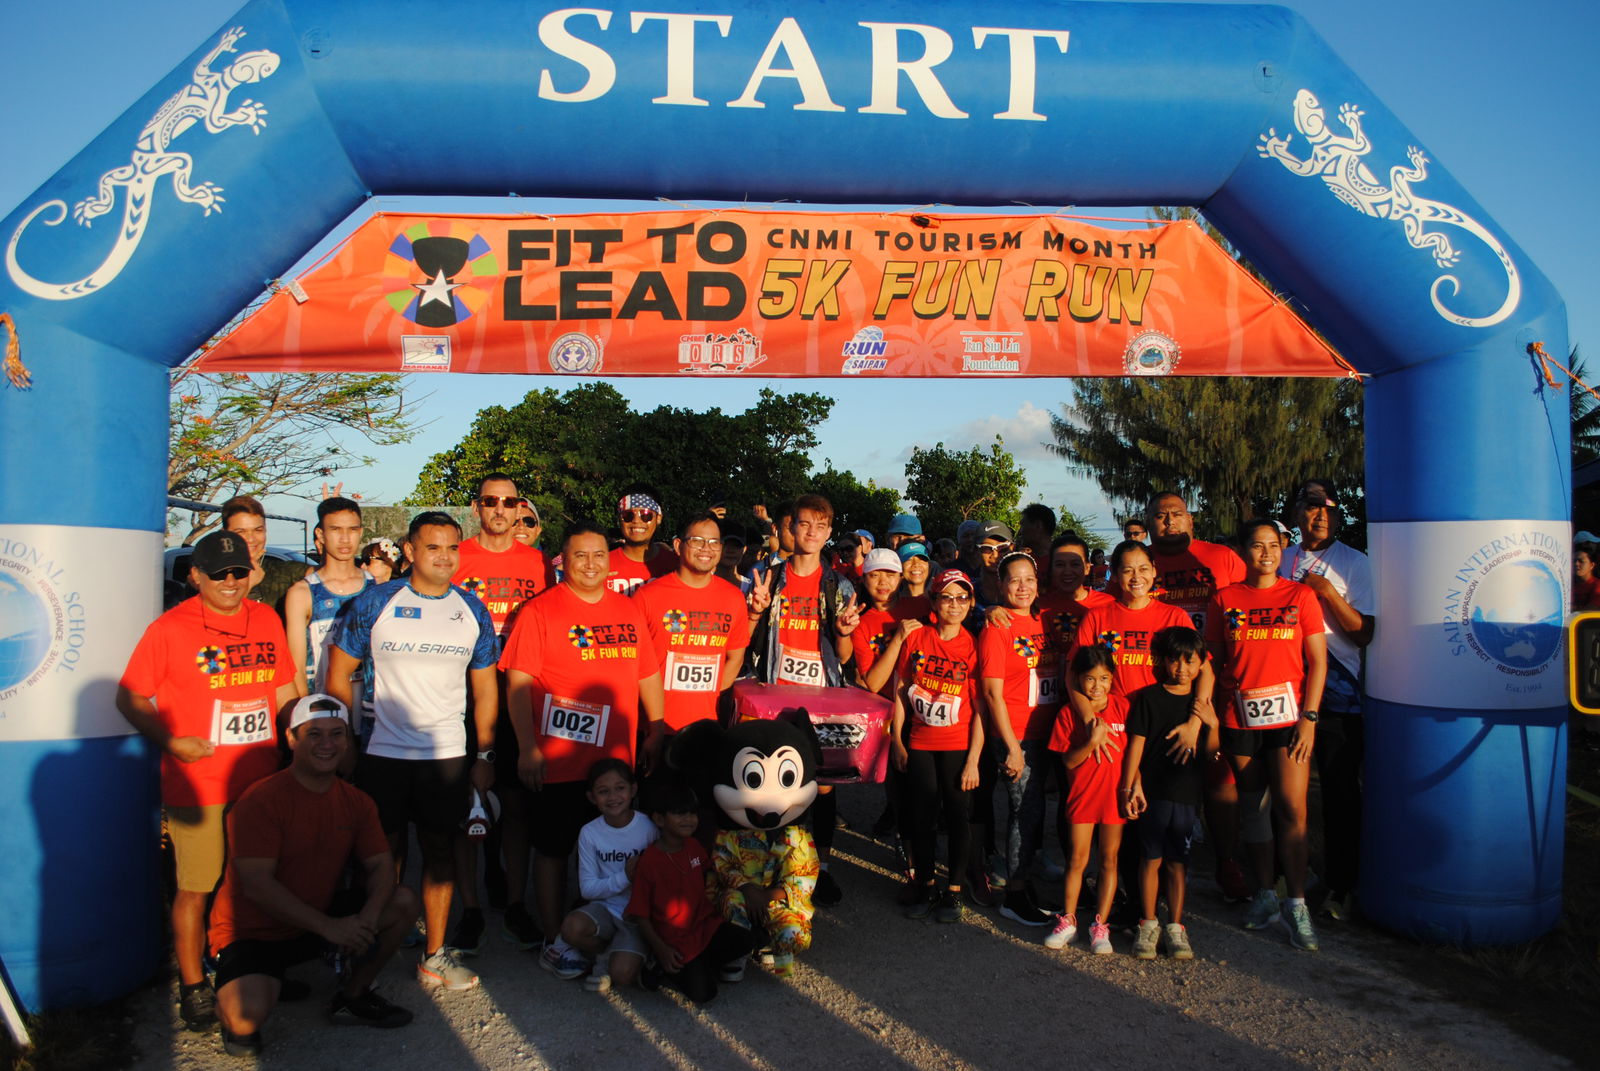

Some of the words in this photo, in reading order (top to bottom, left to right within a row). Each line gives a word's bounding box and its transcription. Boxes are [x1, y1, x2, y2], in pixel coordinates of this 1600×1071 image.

[537, 8, 1070, 121] START
[507, 228, 623, 271] FIT
[647, 220, 747, 265] TO
[767, 228, 852, 250] CNMI
[874, 230, 1022, 252] TOURISM
[1043, 230, 1157, 259] MONTH
[503, 271, 747, 321] LEAD
[757, 258, 851, 321] 5K
[872, 259, 1001, 322] FUN
[1023, 258, 1154, 326] RUN
[843, 341, 887, 355] RUN
[1002, 337, 1020, 353] Lin
[851, 359, 887, 369] SAIPAN
[962, 355, 1019, 371] Foundation
[220, 538, 234, 553] B
[488, 577, 511, 586] FIT
[516, 578, 535, 588] TO
[488, 587, 535, 600] LEAD
[488, 602, 508, 614] FUN
[1249, 607, 1273, 616] FIT
[1278, 605, 1299, 614] TO
[689, 610, 711, 620] FIT
[715, 612, 732, 622] TO
[1248, 615, 1298, 626] LEAD
[55, 591, 85, 672] SCHOOL
[591, 624, 613, 635] FIT
[617, 623, 636, 633] TO
[689, 621, 731, 633] LEAD
[788, 618, 808, 630] FUN
[595, 633, 638, 646] LEAD
[670, 633, 686, 646] 5K
[688, 634, 708, 647] FUN
[1124, 631, 1148, 639] FIT
[1246, 628, 1269, 640] FUN
[1272, 628, 1294, 640] RUN
[225, 643, 251, 655] FIT
[256, 642, 275, 652] TO
[380, 641, 416, 653] RUN
[418, 643, 473, 656] SAIPAN
[581, 648, 597, 661] 5K
[600, 647, 619, 660] FUN
[621, 646, 637, 659] RUN
[1466, 633, 1491, 662] RESPECT
[229, 653, 276, 668] LEAD
[927, 654, 949, 666] FIT
[951, 660, 969, 671] TO
[1122, 653, 1144, 665] FUN
[677, 665, 713, 683] 055
[784, 657, 820, 678] 326
[923, 664, 967, 681] LEAD
[210, 674, 227, 689] 5K
[231, 671, 253, 686] FUN
[921, 677, 939, 690] FUN
[941, 682, 962, 695] RUN
[915, 698, 946, 720] 074
[1247, 696, 1285, 718] 327
[226, 711, 268, 735] 482
[552, 709, 596, 735] 002
